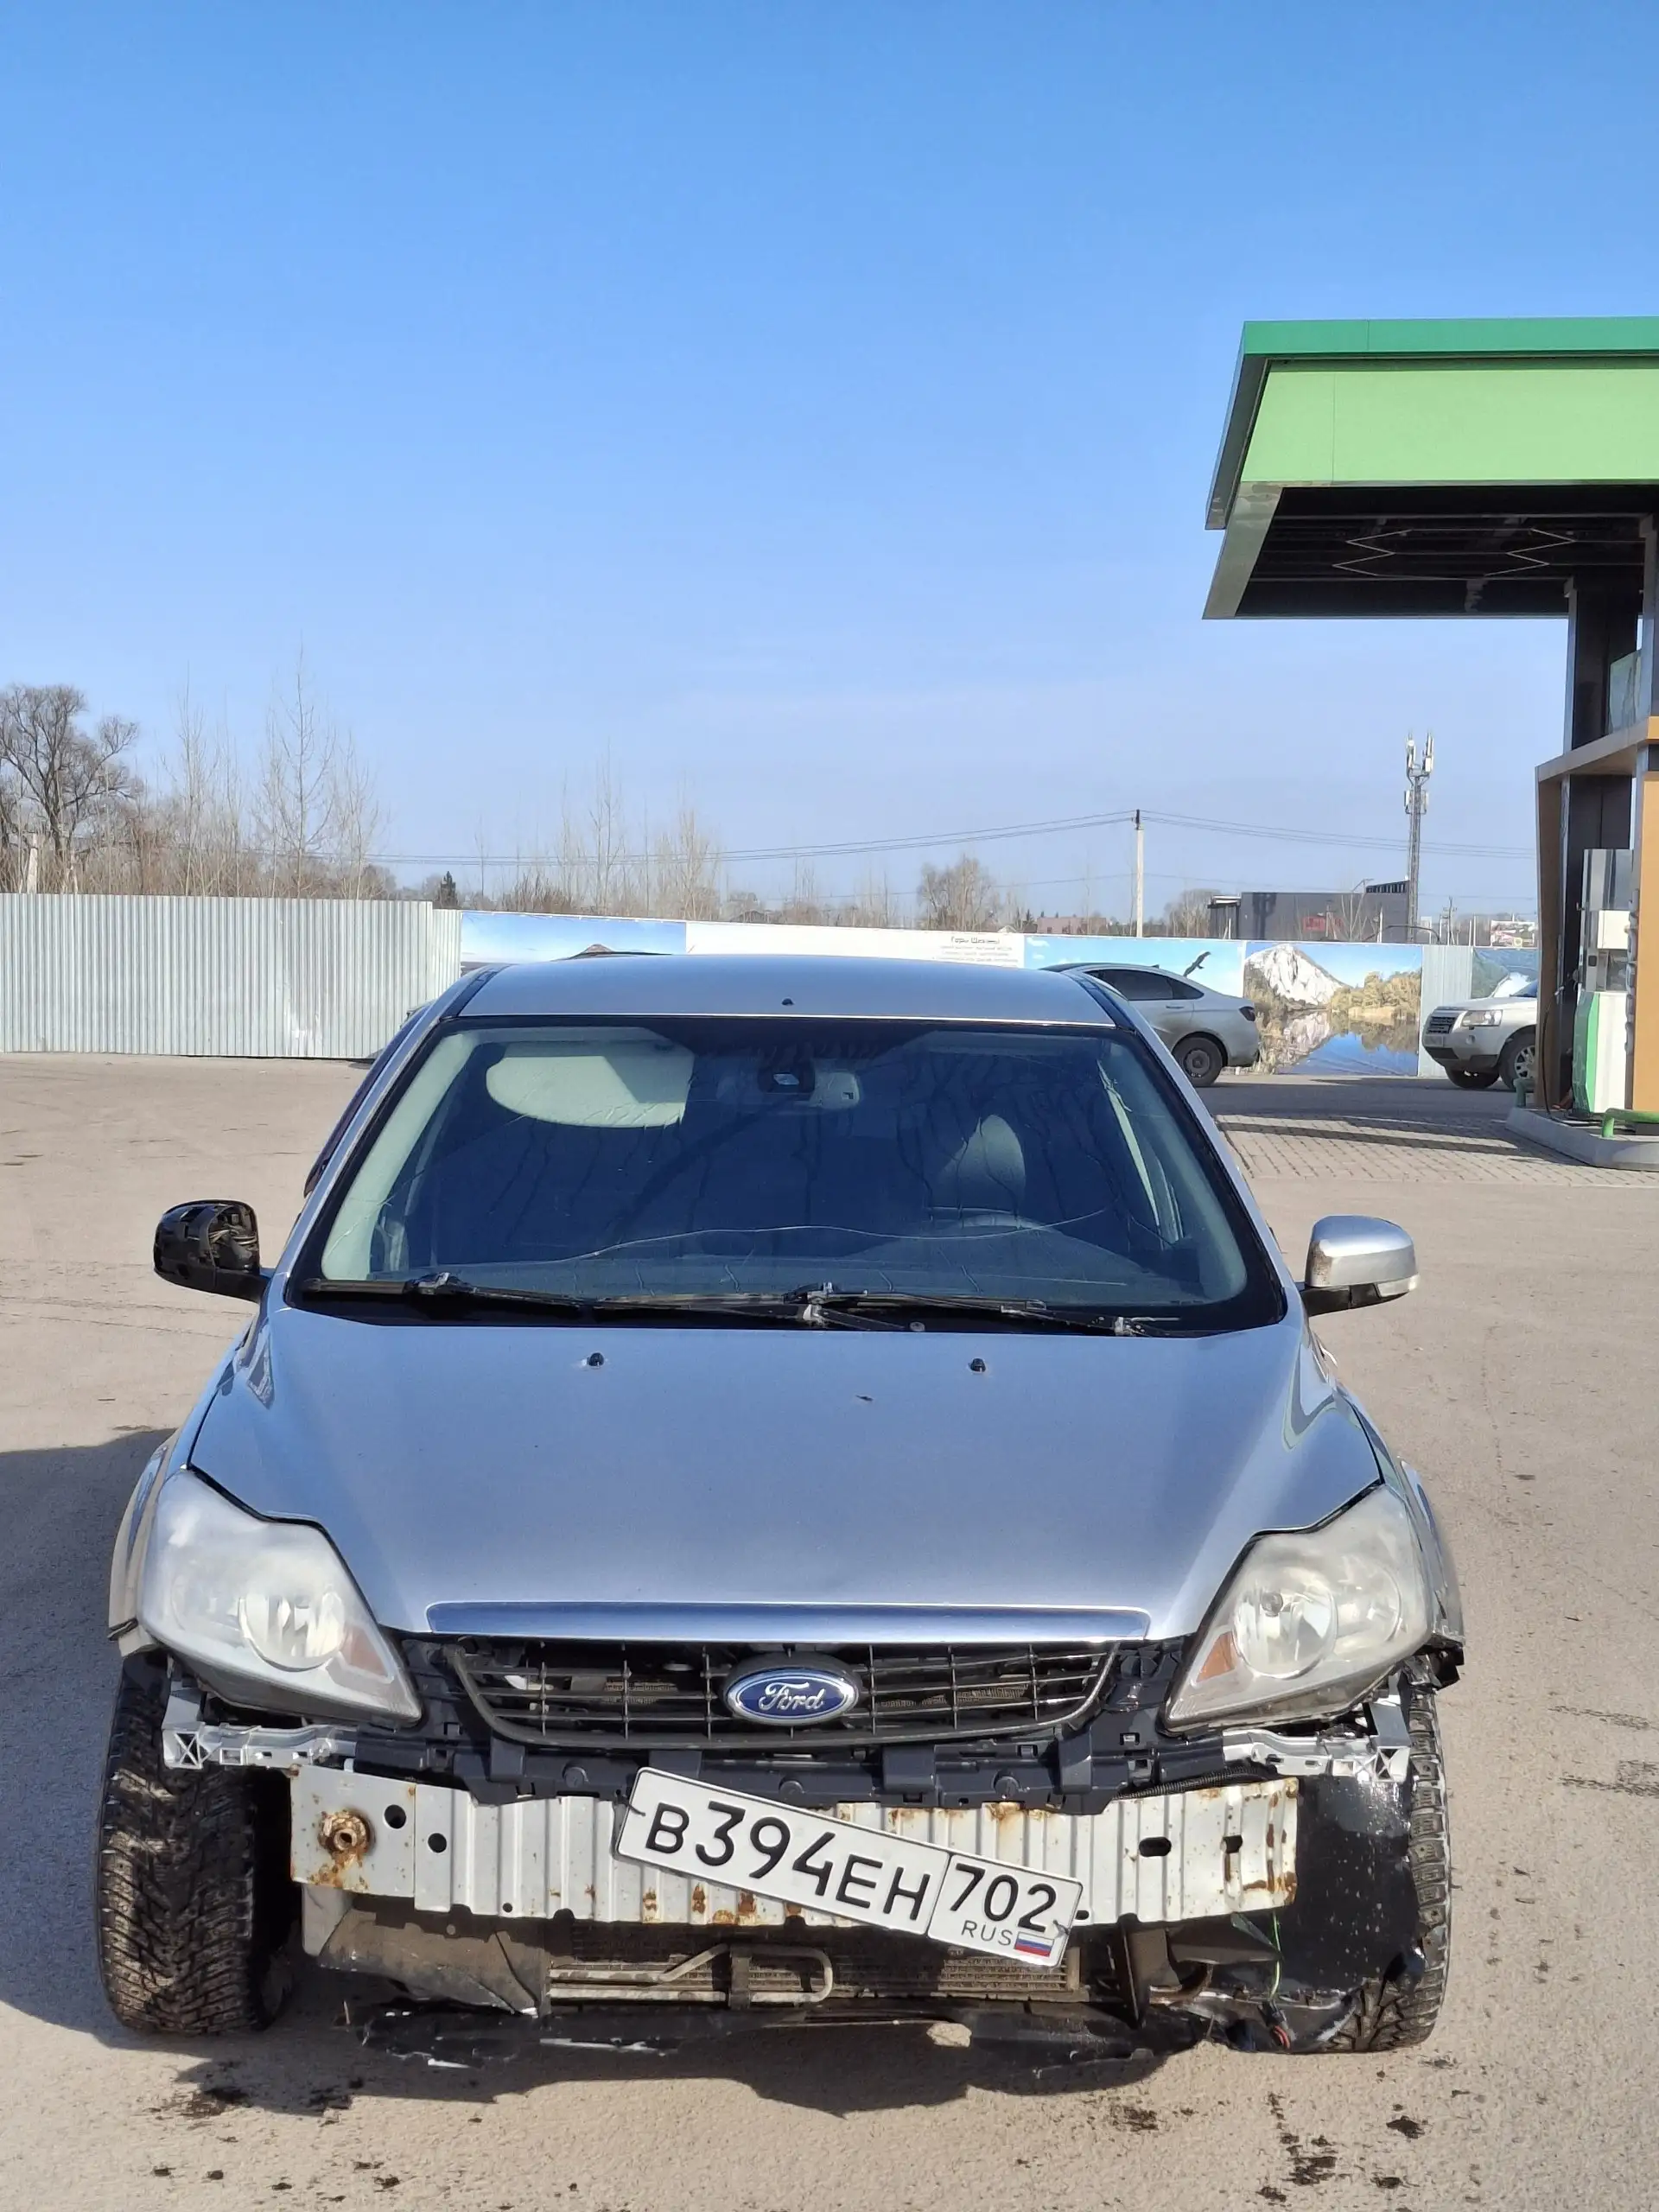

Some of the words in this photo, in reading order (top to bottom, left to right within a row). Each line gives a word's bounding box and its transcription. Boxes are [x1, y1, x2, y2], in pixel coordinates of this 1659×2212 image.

[758, 1681, 827, 1712] Ford
[950, 1862, 1057, 1933] 702
[961, 1919, 1014, 1946] RUS
